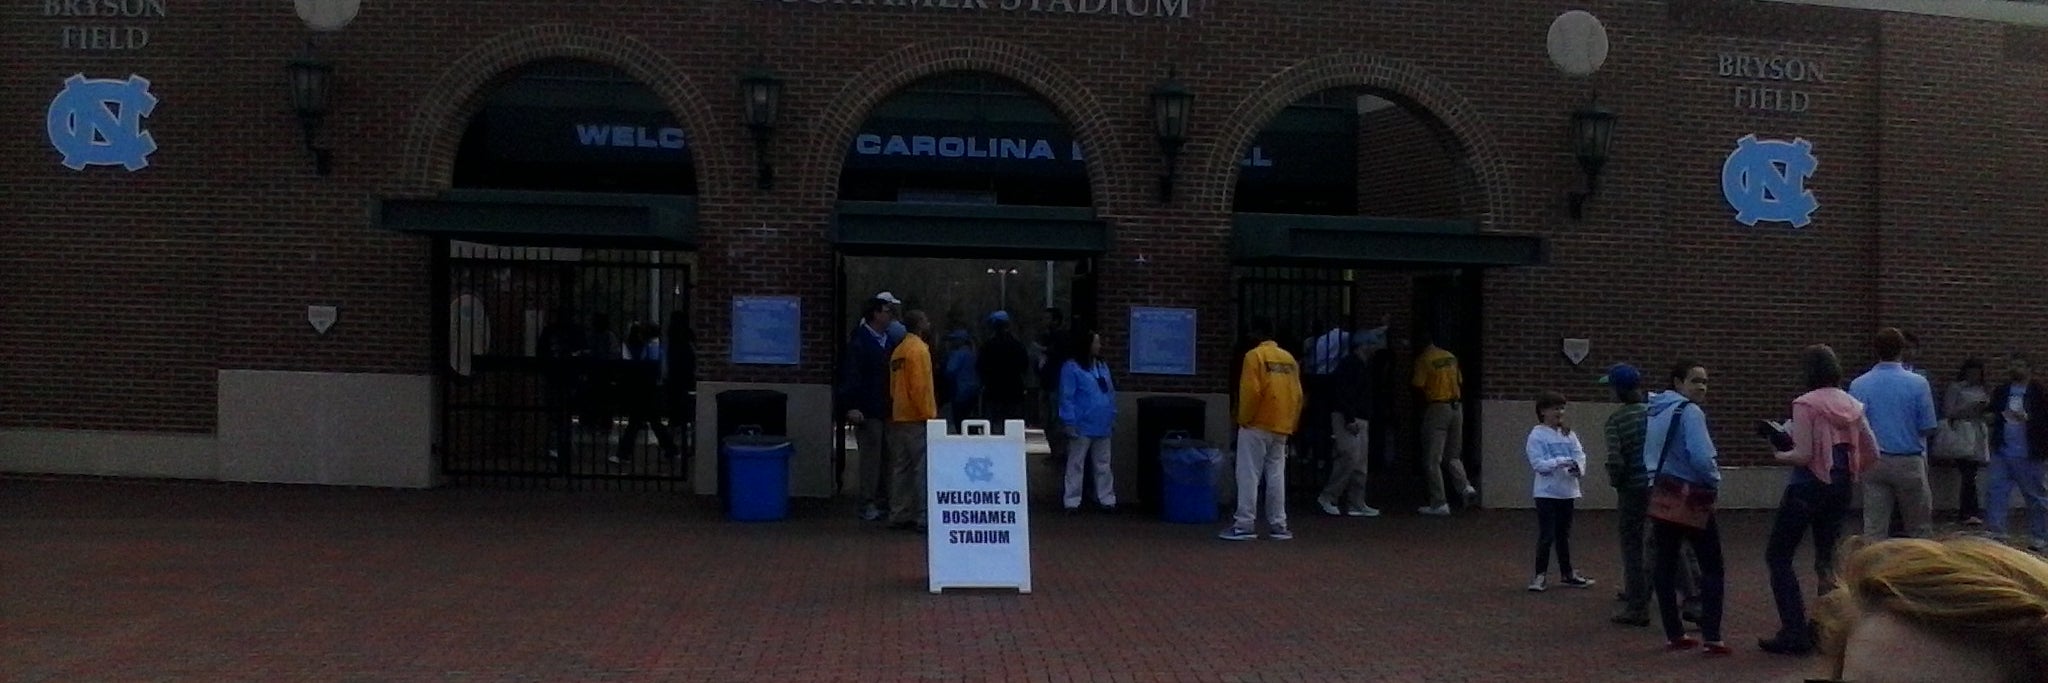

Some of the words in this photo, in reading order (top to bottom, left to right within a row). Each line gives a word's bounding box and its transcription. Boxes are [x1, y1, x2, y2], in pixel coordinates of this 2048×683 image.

[43, 0, 165, 17] BRYSON
[60, 25, 150, 50] FIELD
[1718, 53, 1825, 82] BRYSON
[1734, 85, 1810, 113] FIELD
[856, 134, 1056, 160] CAROLINA
[936, 491, 1001, 505] WELCOME
[1003, 491, 1021, 505] TO
[942, 510, 1016, 524] BOSHAMER
[949, 530, 1010, 544] STADIUM
